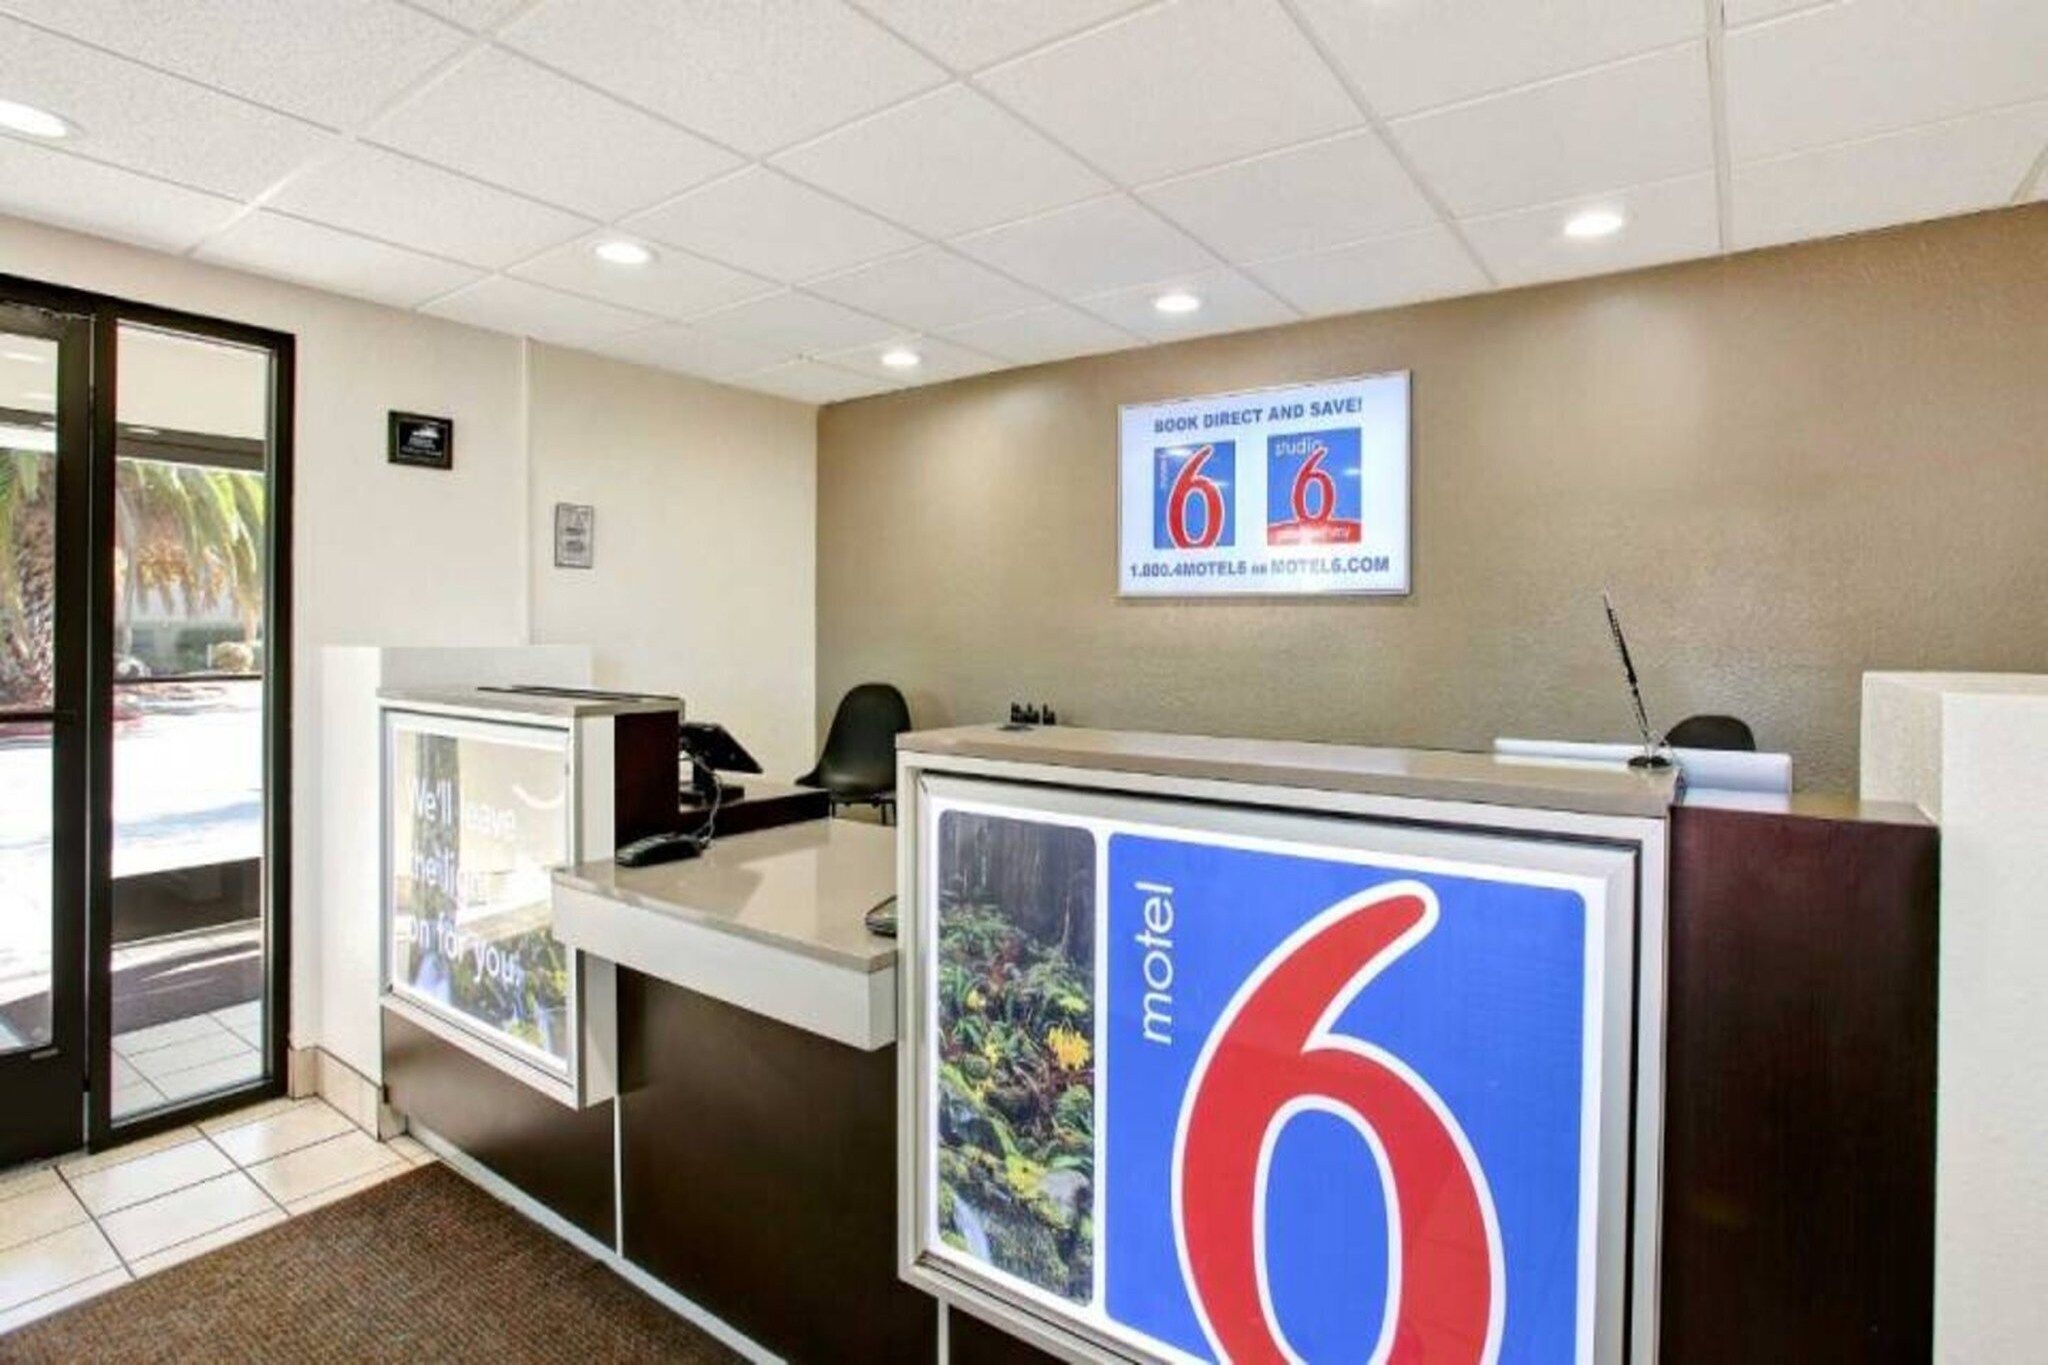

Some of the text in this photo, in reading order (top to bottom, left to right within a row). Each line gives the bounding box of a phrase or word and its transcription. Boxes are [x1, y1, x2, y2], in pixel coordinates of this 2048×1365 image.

[1154, 396, 1363, 433] BOOK DIRECT AND SAVE!
[1166, 443, 1225, 550] 6
[1291, 446, 1337, 521] 6
[1135, 878, 1507, 1365] motel 6
